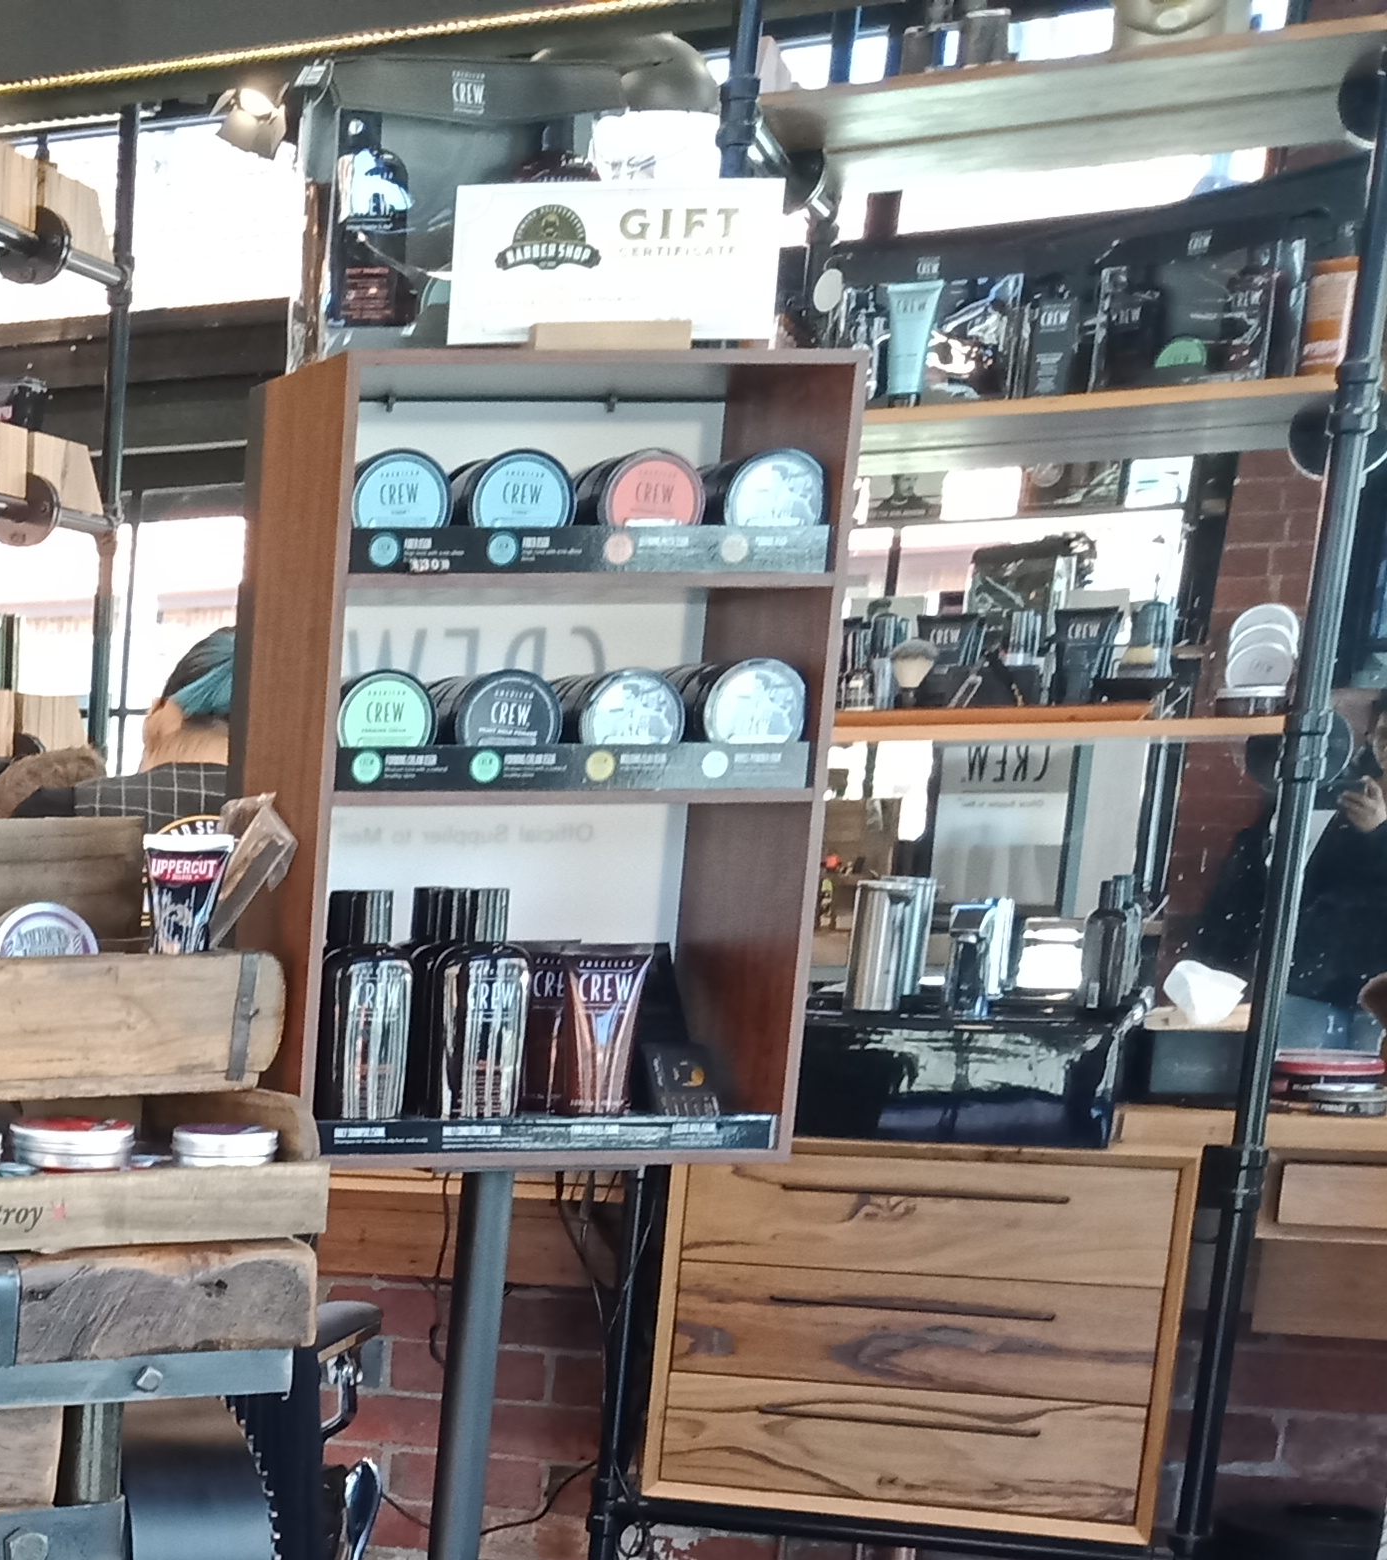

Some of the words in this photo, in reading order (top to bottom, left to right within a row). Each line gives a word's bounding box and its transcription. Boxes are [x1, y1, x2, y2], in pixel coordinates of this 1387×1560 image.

[451, 82, 486, 104] CREW
[619, 208, 740, 240] GIFT
[505, 243, 592, 264] BARBERSHOP
[1039, 309, 1071, 327] CREW
[379, 482, 419, 505] CREW
[502, 481, 543, 505] CREW
[635, 481, 674, 504] CREW
[929, 627, 961, 643] CREW
[1067, 622, 1101, 639] CREW
[365, 701, 405, 724] CREW
[490, 701, 530, 726] CREW
[151, 858, 218, 876] UPPERCUT
[355, 982, 401, 1009] CREW
[532, 970, 564, 998] CRE
[578, 973, 633, 1002] CREW
[468, 982, 515, 1010] CREW
